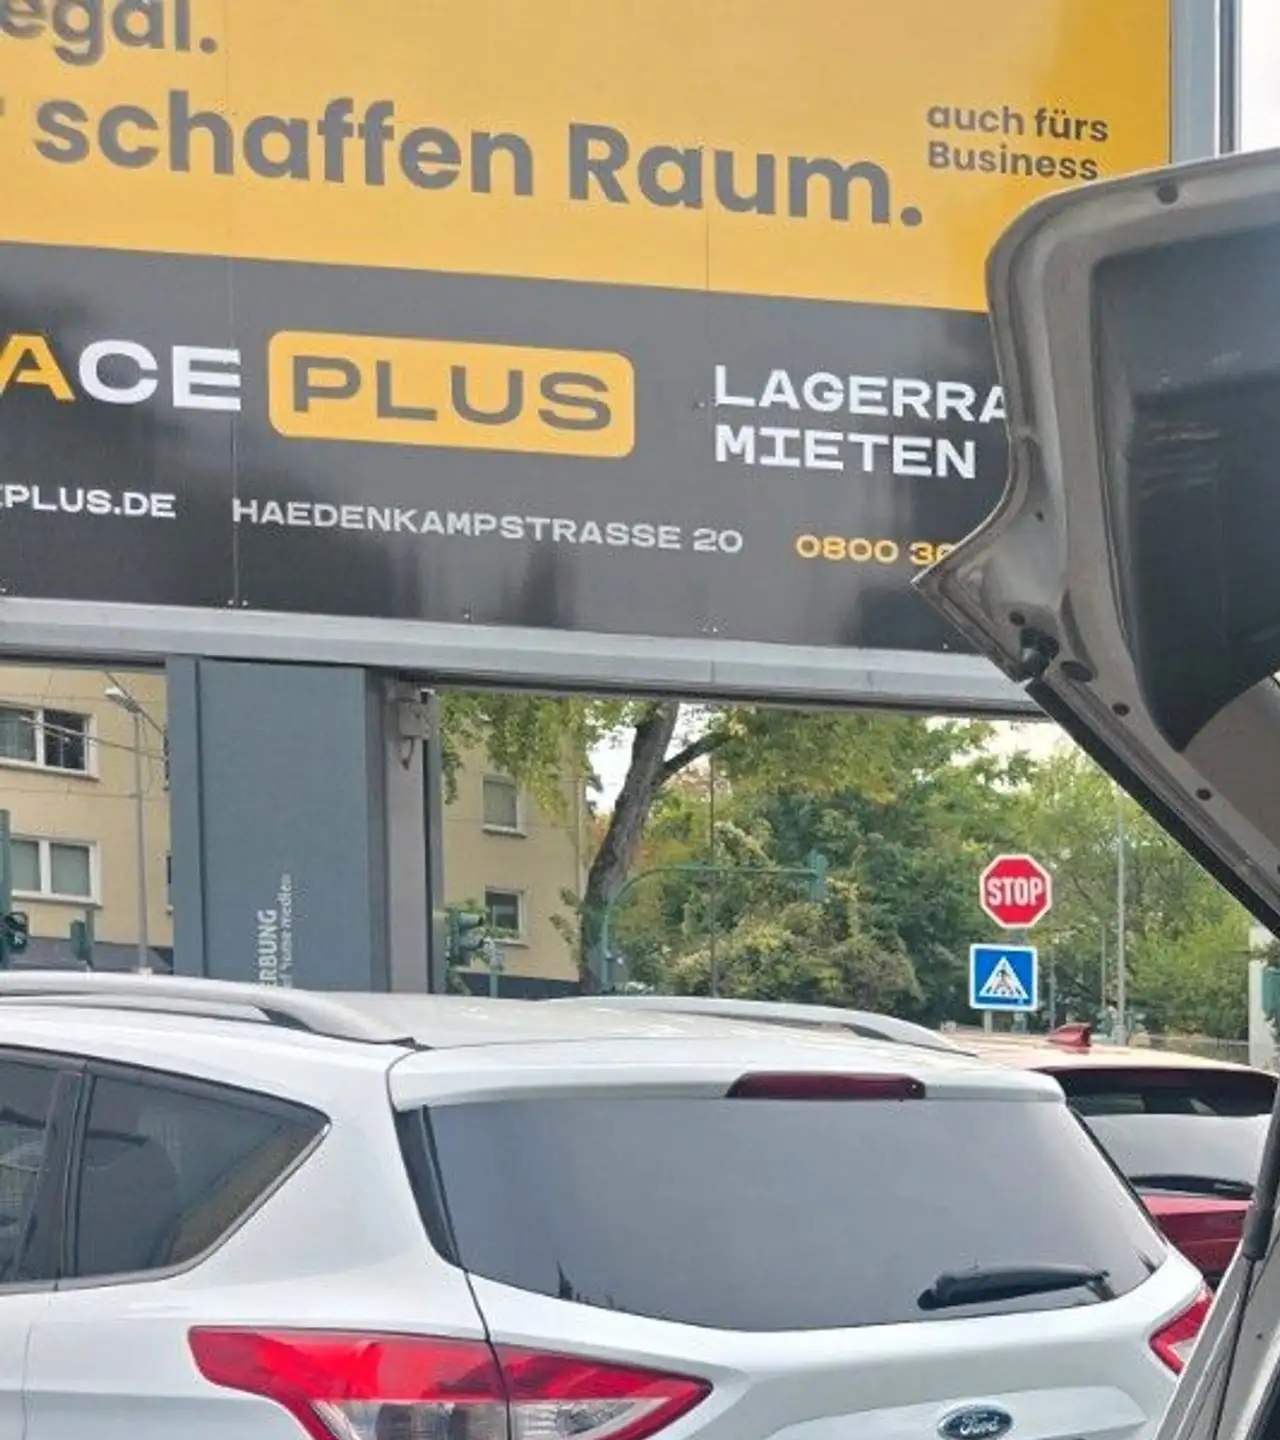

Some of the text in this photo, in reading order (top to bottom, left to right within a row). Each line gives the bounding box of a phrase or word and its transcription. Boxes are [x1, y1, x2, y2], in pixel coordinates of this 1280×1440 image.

[0, 0, 219, 66] egal.
[926, 99, 1109, 143] auch fürs
[34, 89, 923, 227] schaffen Raum.
[927, 140, 1099, 181] Business
[0, 332, 612, 431] ACE PLUS
[714, 364, 1007, 424] LAGERRA
[714, 424, 976, 480] MIETEN
[0, 483, 176, 519] PLUS.DE
[232, 497, 744, 554] HAEDENKAMPSTRASSE 20
[795, 533, 899, 565] 0800
[986, 877, 1044, 906] STOP
[960, 1413, 1001, 1436] Ford
